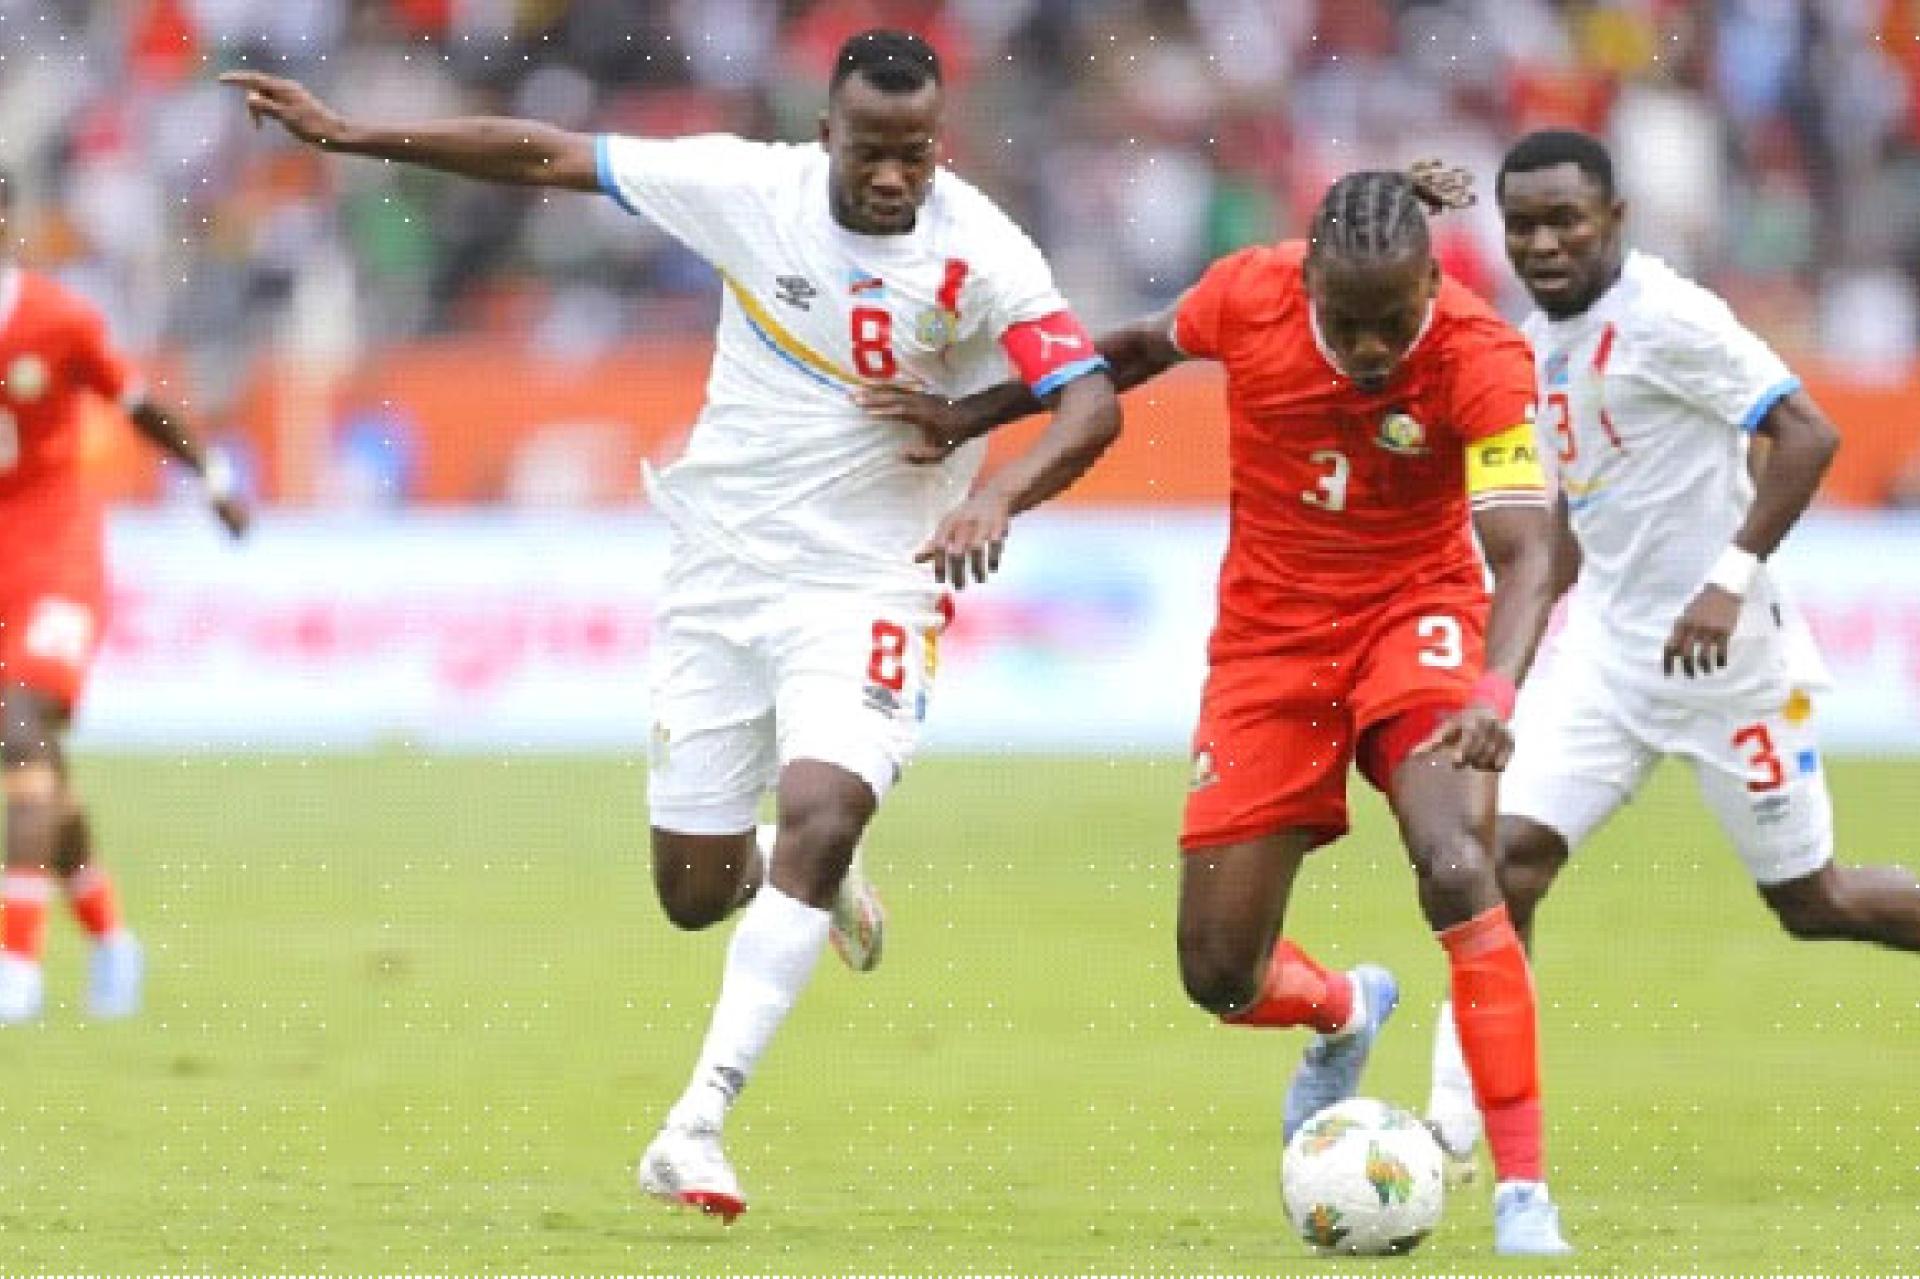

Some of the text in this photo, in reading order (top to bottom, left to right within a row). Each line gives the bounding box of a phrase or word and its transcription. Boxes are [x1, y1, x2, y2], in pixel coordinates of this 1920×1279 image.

[850, 307, 897, 378] 8
[1546, 394, 1577, 462] 3
[1301, 451, 1350, 510] 3
[867, 620, 907, 690] 8
[1415, 615, 1462, 668] 3
[1732, 723, 1784, 792] 3
